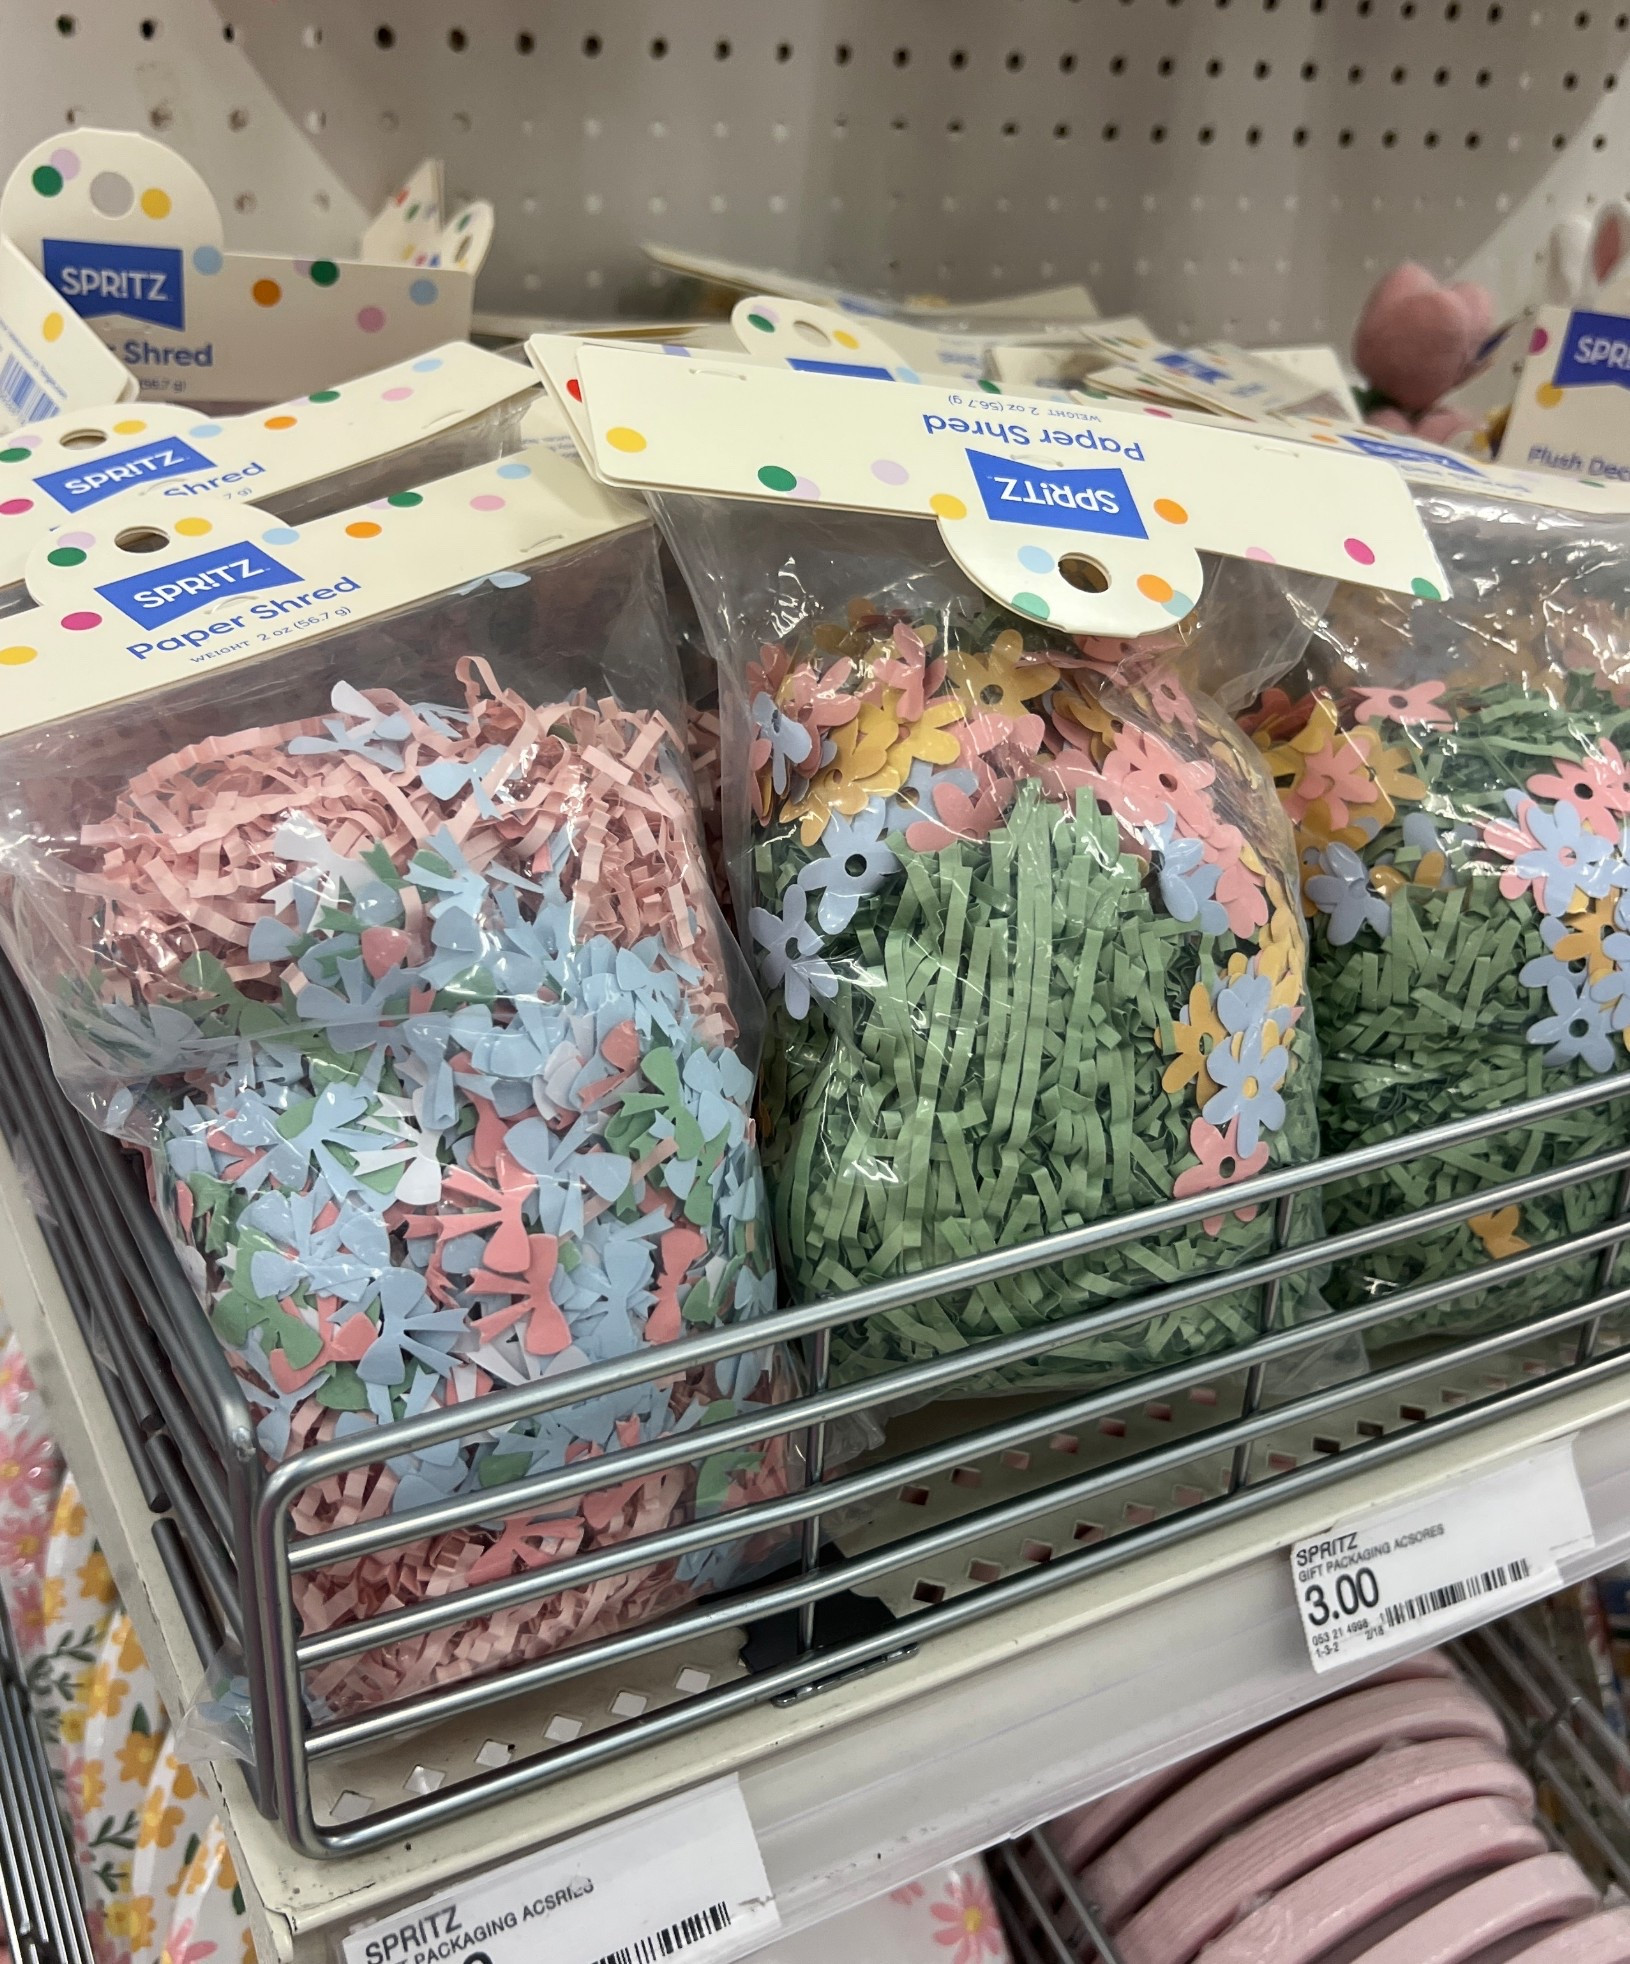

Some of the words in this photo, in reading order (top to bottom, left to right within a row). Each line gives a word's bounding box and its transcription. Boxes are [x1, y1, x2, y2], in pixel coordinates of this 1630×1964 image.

[124, 339, 213, 367] Shred
[948, 394, 963, 406] g)
[968, 399, 1004, 412] (56.7
[1008, 403, 1025, 412] oz
[1030, 406, 1040, 416] 2
[1047, 409, 1102, 423] WEIGHT
[922, 413, 1031, 446] Shred
[1039, 428, 1145, 462] Paper
[126, 615, 246, 661] Paper
[250, 576, 362, 620] Shred
[190, 640, 251, 664] WEIGHT
[256, 634, 271, 642] 2
[272, 626, 293, 636] oz
[293, 612, 331, 631] (56.7
[335, 606, 351, 622] g)
[1296, 1532, 1358, 1566] SPRITZ
[1298, 1564, 1323, 1583] GIFT
[1326, 1541, 1391, 1574] PACKAGING
[1393, 1523, 1445, 1549] ACSORES
[1305, 1567, 1380, 1626] 3.00
[365, 1904, 463, 1964] SPRITZ
[414, 1912, 518, 1964] PACKAGING
